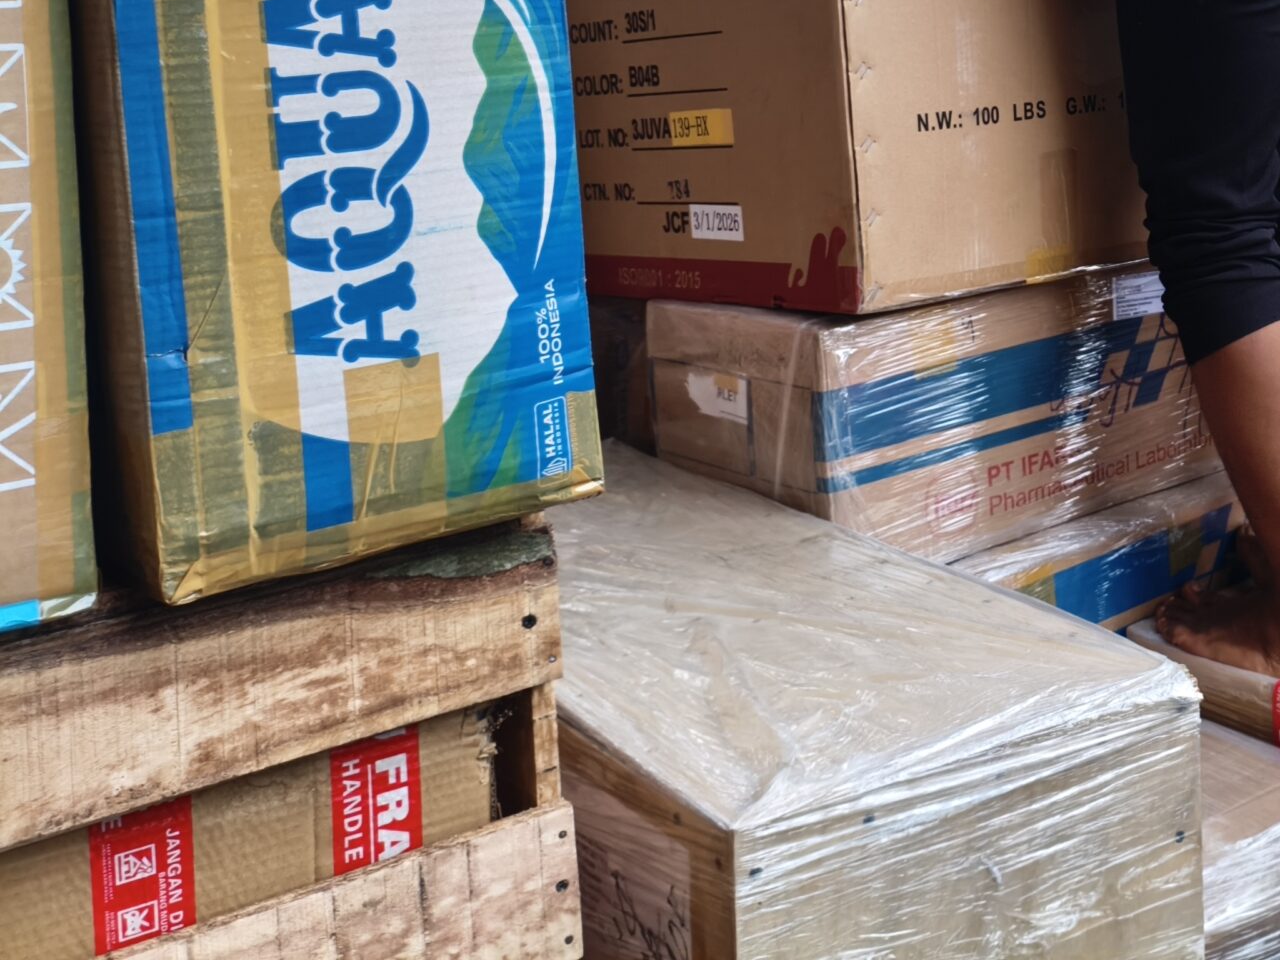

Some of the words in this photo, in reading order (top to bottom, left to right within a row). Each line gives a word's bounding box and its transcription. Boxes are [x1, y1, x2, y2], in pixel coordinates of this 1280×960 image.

[570, 19, 619, 44] COUNT:
[575, 73, 624, 97] COLOR:
[916, 109, 964, 133] N.W.:
[972, 105, 1000, 127] 100
[1012, 100, 1047, 122] LBS
[608, 127, 630, 148] NO:
[614, 183, 636, 202] NO:
[662, 211, 689, 234] JCF
[674, 269, 702, 289] 2015
[536, 307, 550, 364] 100%
[544, 278, 564, 386] INDONESIA
[542, 403, 556, 459] HALAL
[986, 459, 1015, 488] PT
[341, 757, 365, 864] HANDLE
[374, 752, 411, 862] FRA
[165, 827, 184, 904] JANGAN
